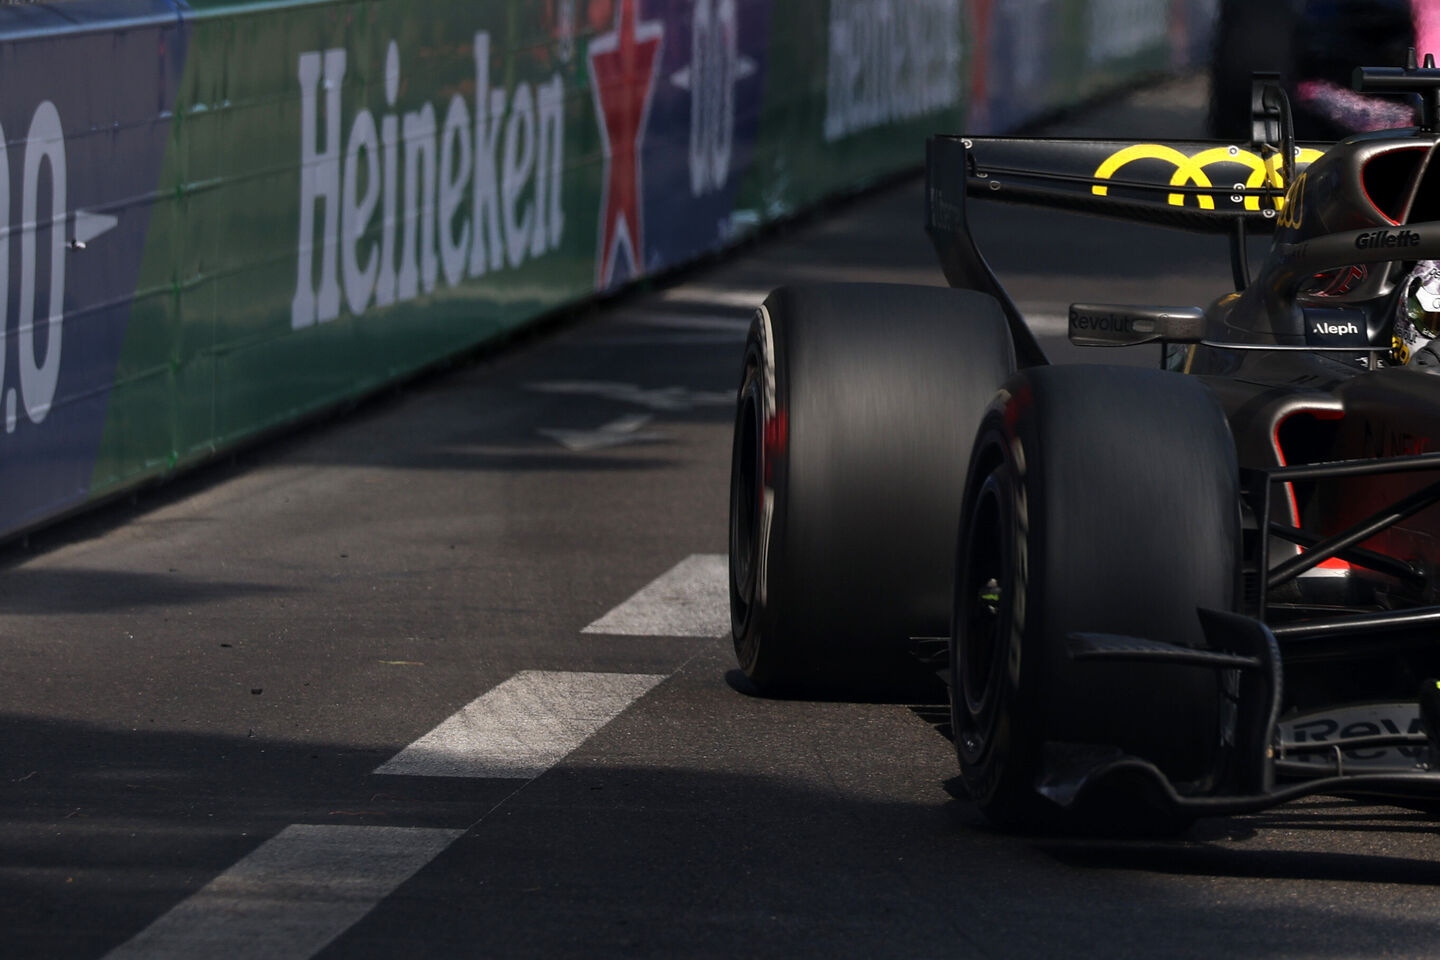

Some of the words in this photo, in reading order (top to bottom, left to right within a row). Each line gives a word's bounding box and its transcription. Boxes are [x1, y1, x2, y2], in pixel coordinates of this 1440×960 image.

[290, 30, 566, 330] Heineken
[1355, 230, 1421, 251] Gillette
[0, 100, 67, 434] .0
[1070, 311, 1133, 333] Revolut
[1312, 322, 1358, 336] Aleph
